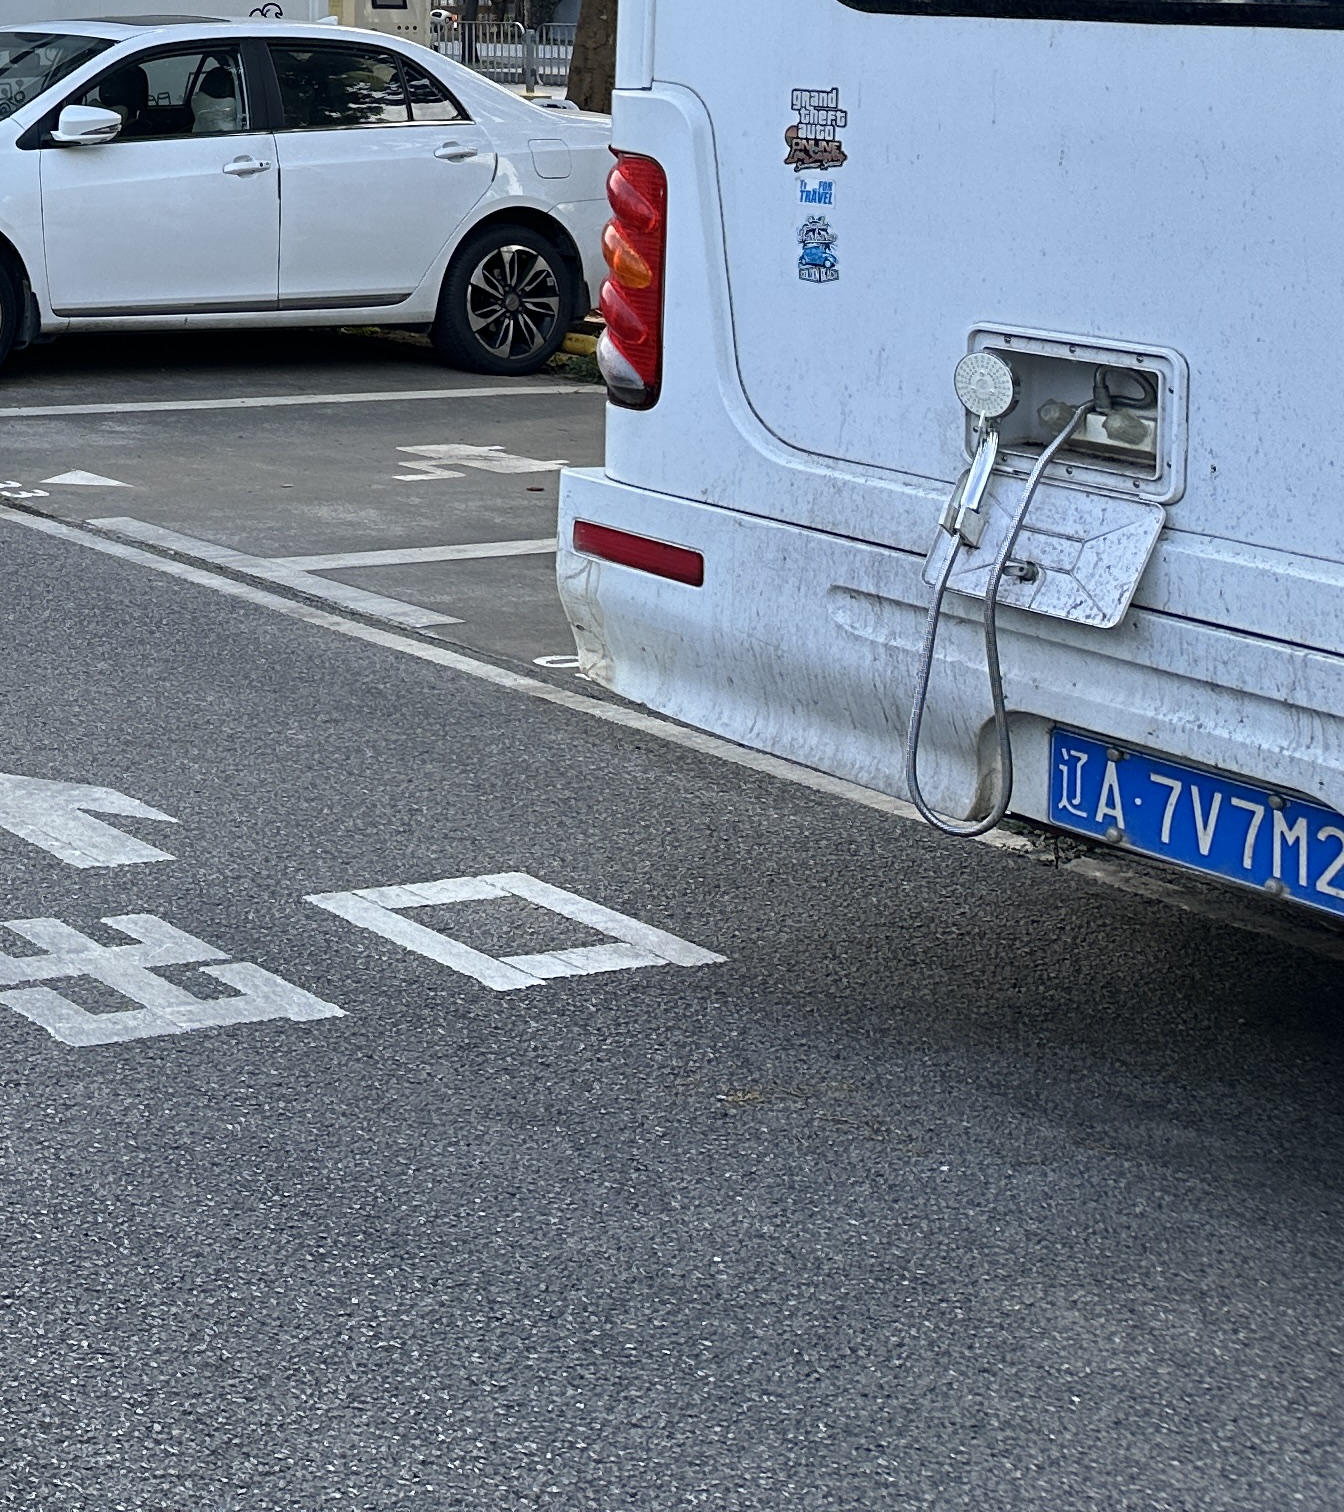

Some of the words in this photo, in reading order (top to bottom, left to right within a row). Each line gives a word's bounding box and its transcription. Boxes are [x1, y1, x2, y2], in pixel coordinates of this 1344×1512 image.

[792, 90, 837, 110] grand
[799, 107, 846, 126] theft
[797, 123, 834, 140] auto
[799, 189, 833, 205] TRAVEL
